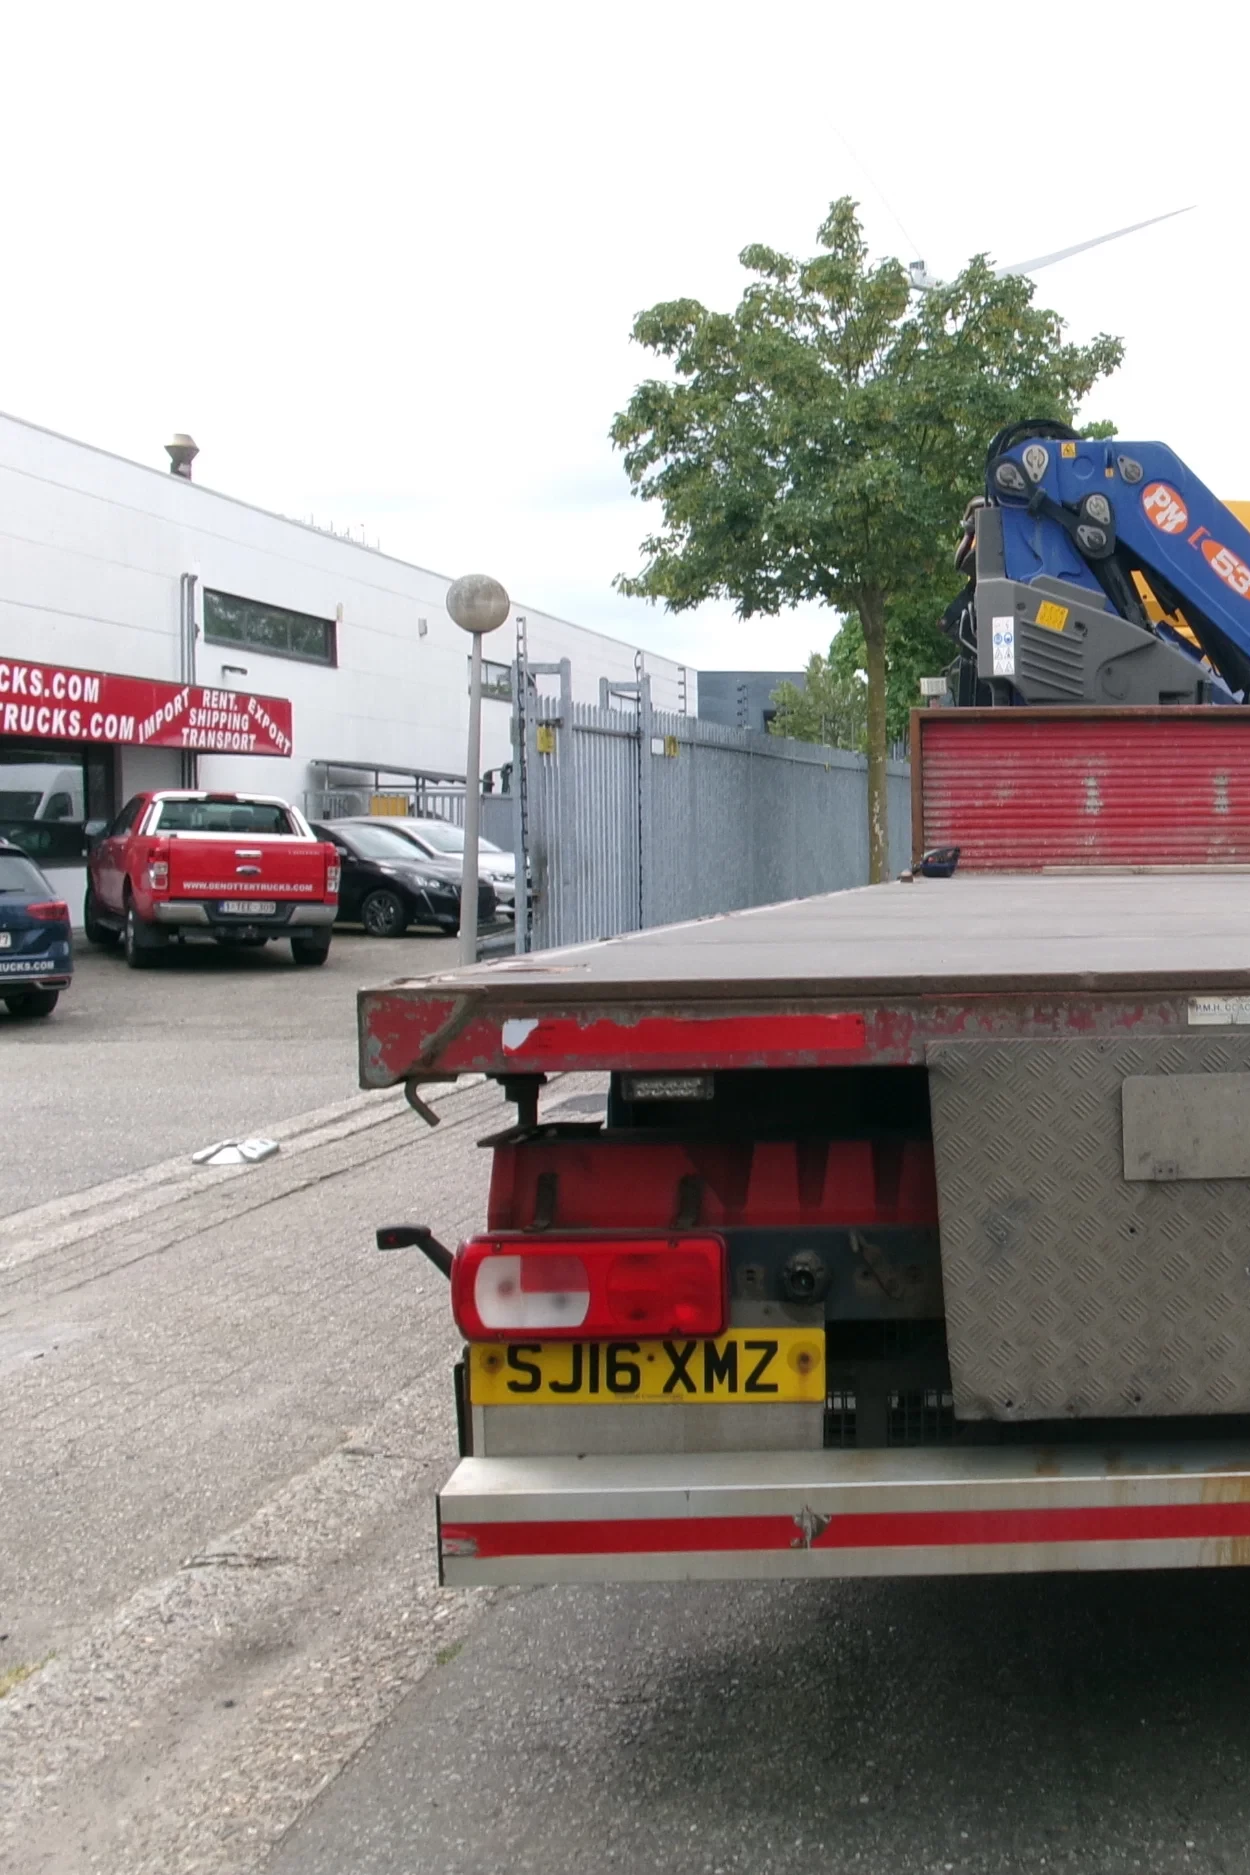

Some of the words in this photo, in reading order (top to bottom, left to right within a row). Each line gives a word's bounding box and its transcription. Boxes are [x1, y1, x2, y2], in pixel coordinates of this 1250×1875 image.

[1144, 485, 1188, 532] PM
[138, 686, 189, 744] IMPORT
[189, 707, 249, 731] SHIPPING
[202, 689, 237, 711] RENT.
[0, 702, 135, 740] RUCKS.COM
[182, 727, 256, 751] TRANSPORT
[248, 697, 291, 755] EXPORT
[0, 960, 54, 972] UCKS.COM
[506, 1341, 641, 1394] SJ16
[662, 1340, 779, 1393] XMZ
